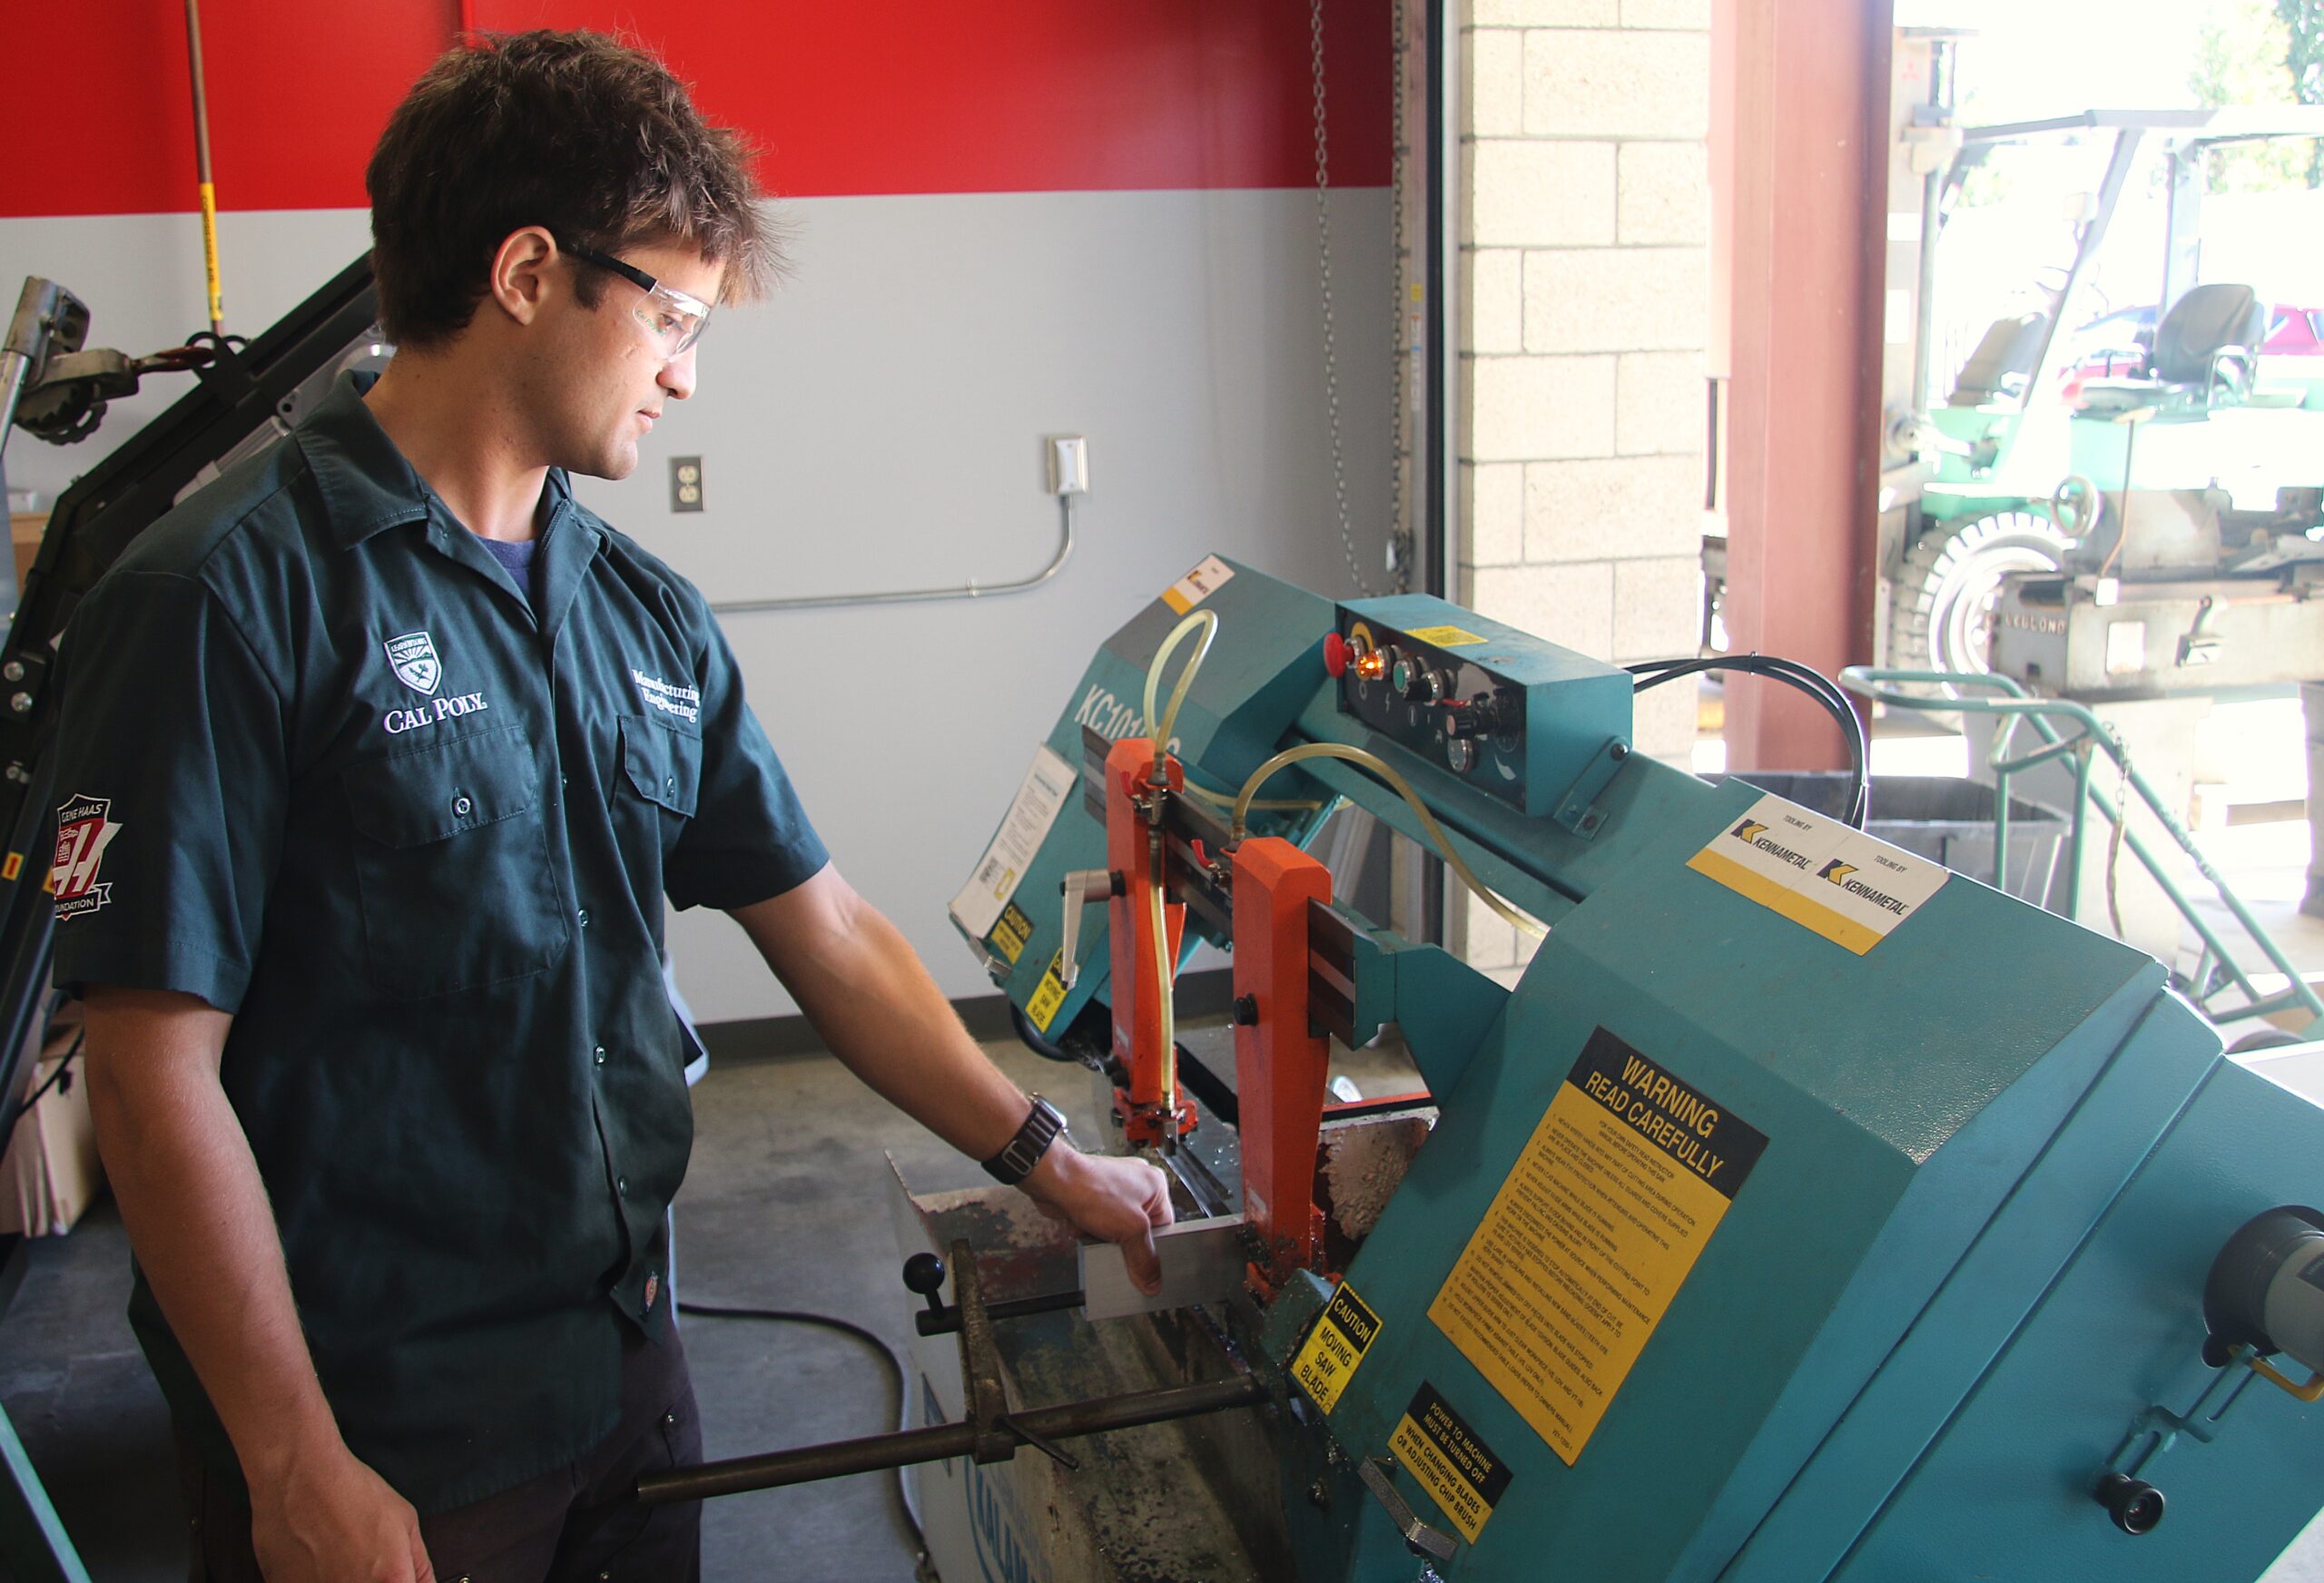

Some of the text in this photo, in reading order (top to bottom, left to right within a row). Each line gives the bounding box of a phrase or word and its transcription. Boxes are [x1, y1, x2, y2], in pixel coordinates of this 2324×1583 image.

[384, 707, 432, 733] CAL
[62, 804, 103, 822] GENE HAAS
[1785, 814, 1805, 828] TOOLING
[1752, 837, 1810, 869] KENNAMETAL
[1874, 855, 1898, 869] TOOLING
[55, 898, 94, 911] OUNDATION
[1842, 879, 1907, 914] KENNAMETAL
[1622, 1056, 1718, 1136] WARNING
[1585, 1071, 1629, 1111] READ
[1628, 1102, 1723, 1176] CAREFULLY
[1334, 1299, 1370, 1342] CAUTION
[1315, 1352, 1335, 1376] SAW
[1320, 1326, 1351, 1366] MOVING
[1300, 1364, 1328, 1401] BLADE
[1423, 1413, 1484, 1482] MUST BE TURNED OFF
[1430, 1402, 1492, 1472] POWER TO MACHINE
[1396, 1434, 1475, 1529] OR ADJUSTING CHIP BRUSH
[1405, 1425, 1480, 1513] WHEN CHANGING BLADES
